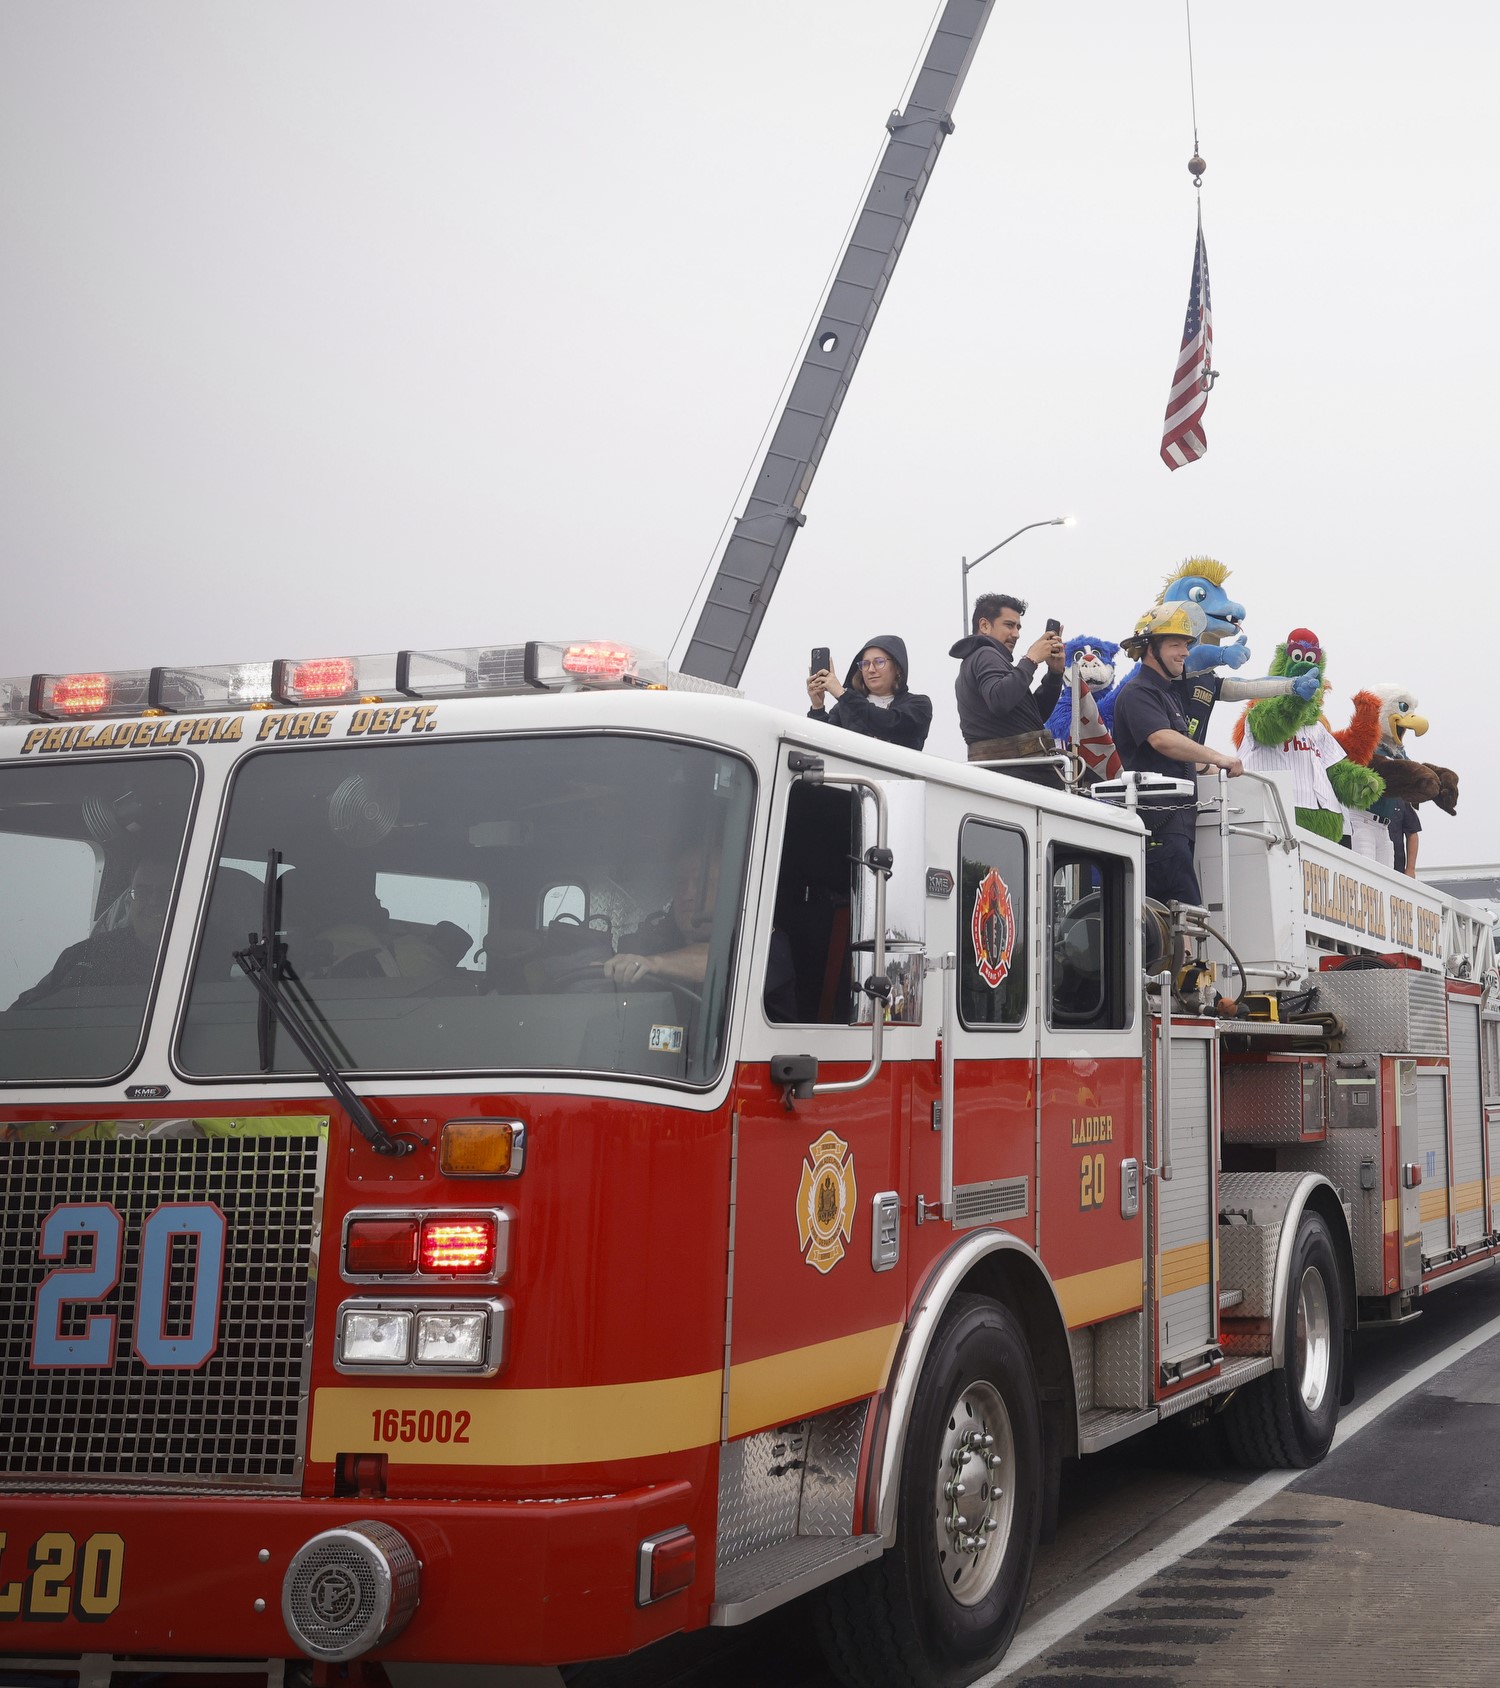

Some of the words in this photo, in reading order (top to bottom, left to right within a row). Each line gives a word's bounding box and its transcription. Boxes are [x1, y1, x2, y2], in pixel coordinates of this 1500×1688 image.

[20, 716, 244, 754] PHILADELPHIA
[255, 710, 339, 741] FIRE
[347, 705, 438, 736] DEPT.
[1302, 859, 1386, 941] PHILADELPHIA
[1390, 894, 1413, 949] FIRE
[1417, 905, 1442, 959] DEPT.
[1072, 1115, 1113, 1147] LADDER
[1080, 1153, 1105, 1211] 20
[29, 1201, 227, 1370] 20
[372, 1408, 471, 1443] 165002
